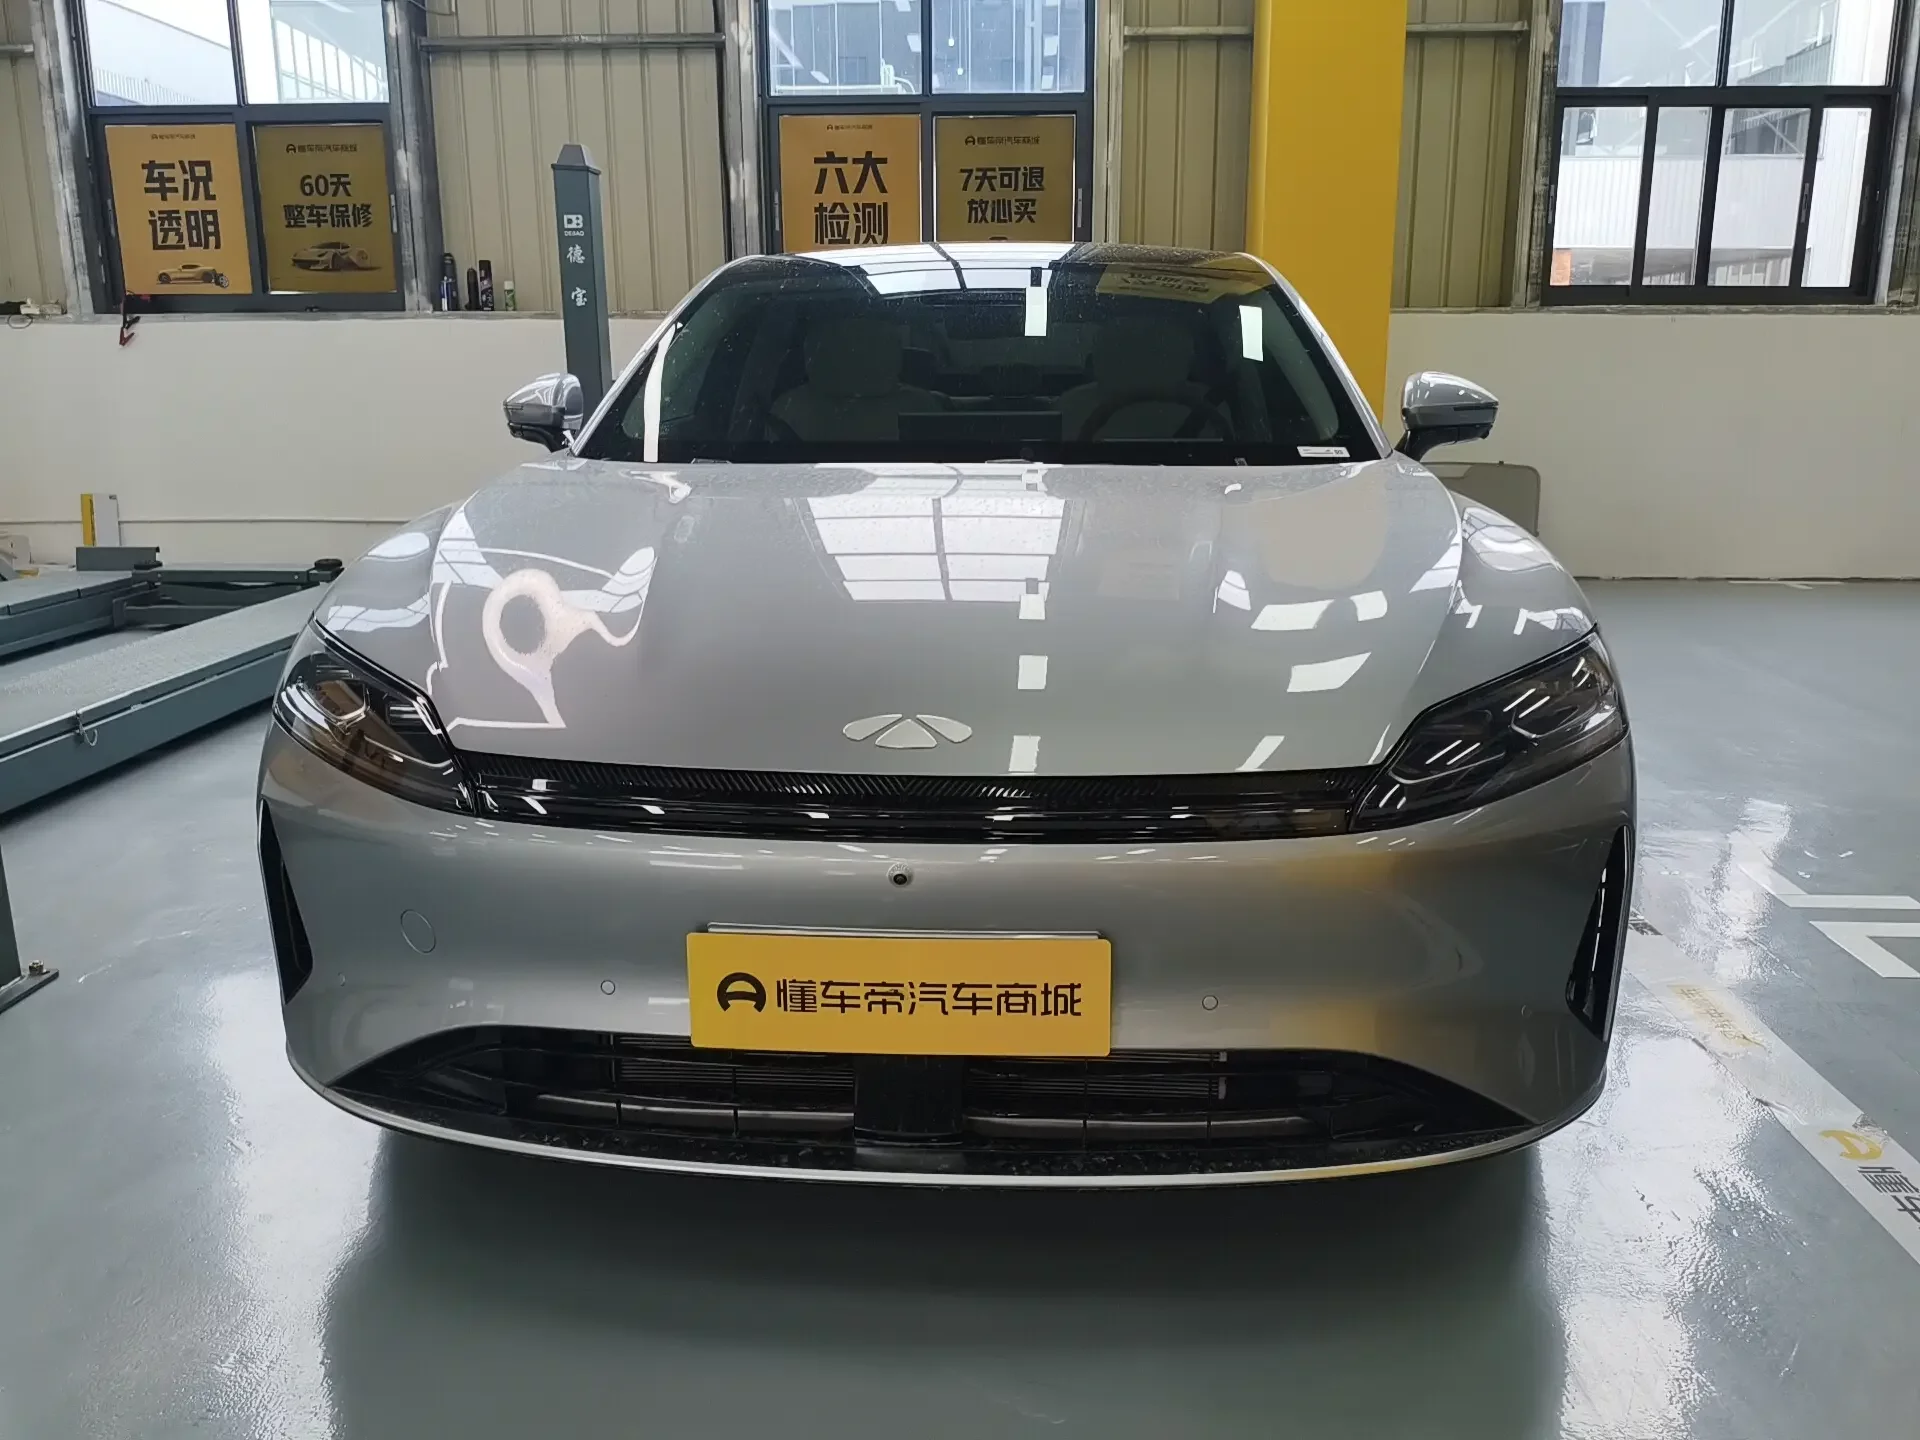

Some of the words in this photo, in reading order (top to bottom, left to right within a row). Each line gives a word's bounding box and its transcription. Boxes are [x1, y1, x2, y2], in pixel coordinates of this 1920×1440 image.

[141, 160, 216, 201] 车况
[301, 173, 352, 197] 60天
[814, 151, 888, 194] 六大
[959, 166, 1045, 192] 7天可退
[148, 209, 221, 250] 透明
[283, 204, 373, 228] 整车保修
[814, 202, 888, 244] 检测
[967, 198, 1036, 223] 放心买
[566, 244, 587, 307] 德宝
[776, 978, 1082, 1017] 懂车帝汽车商城
